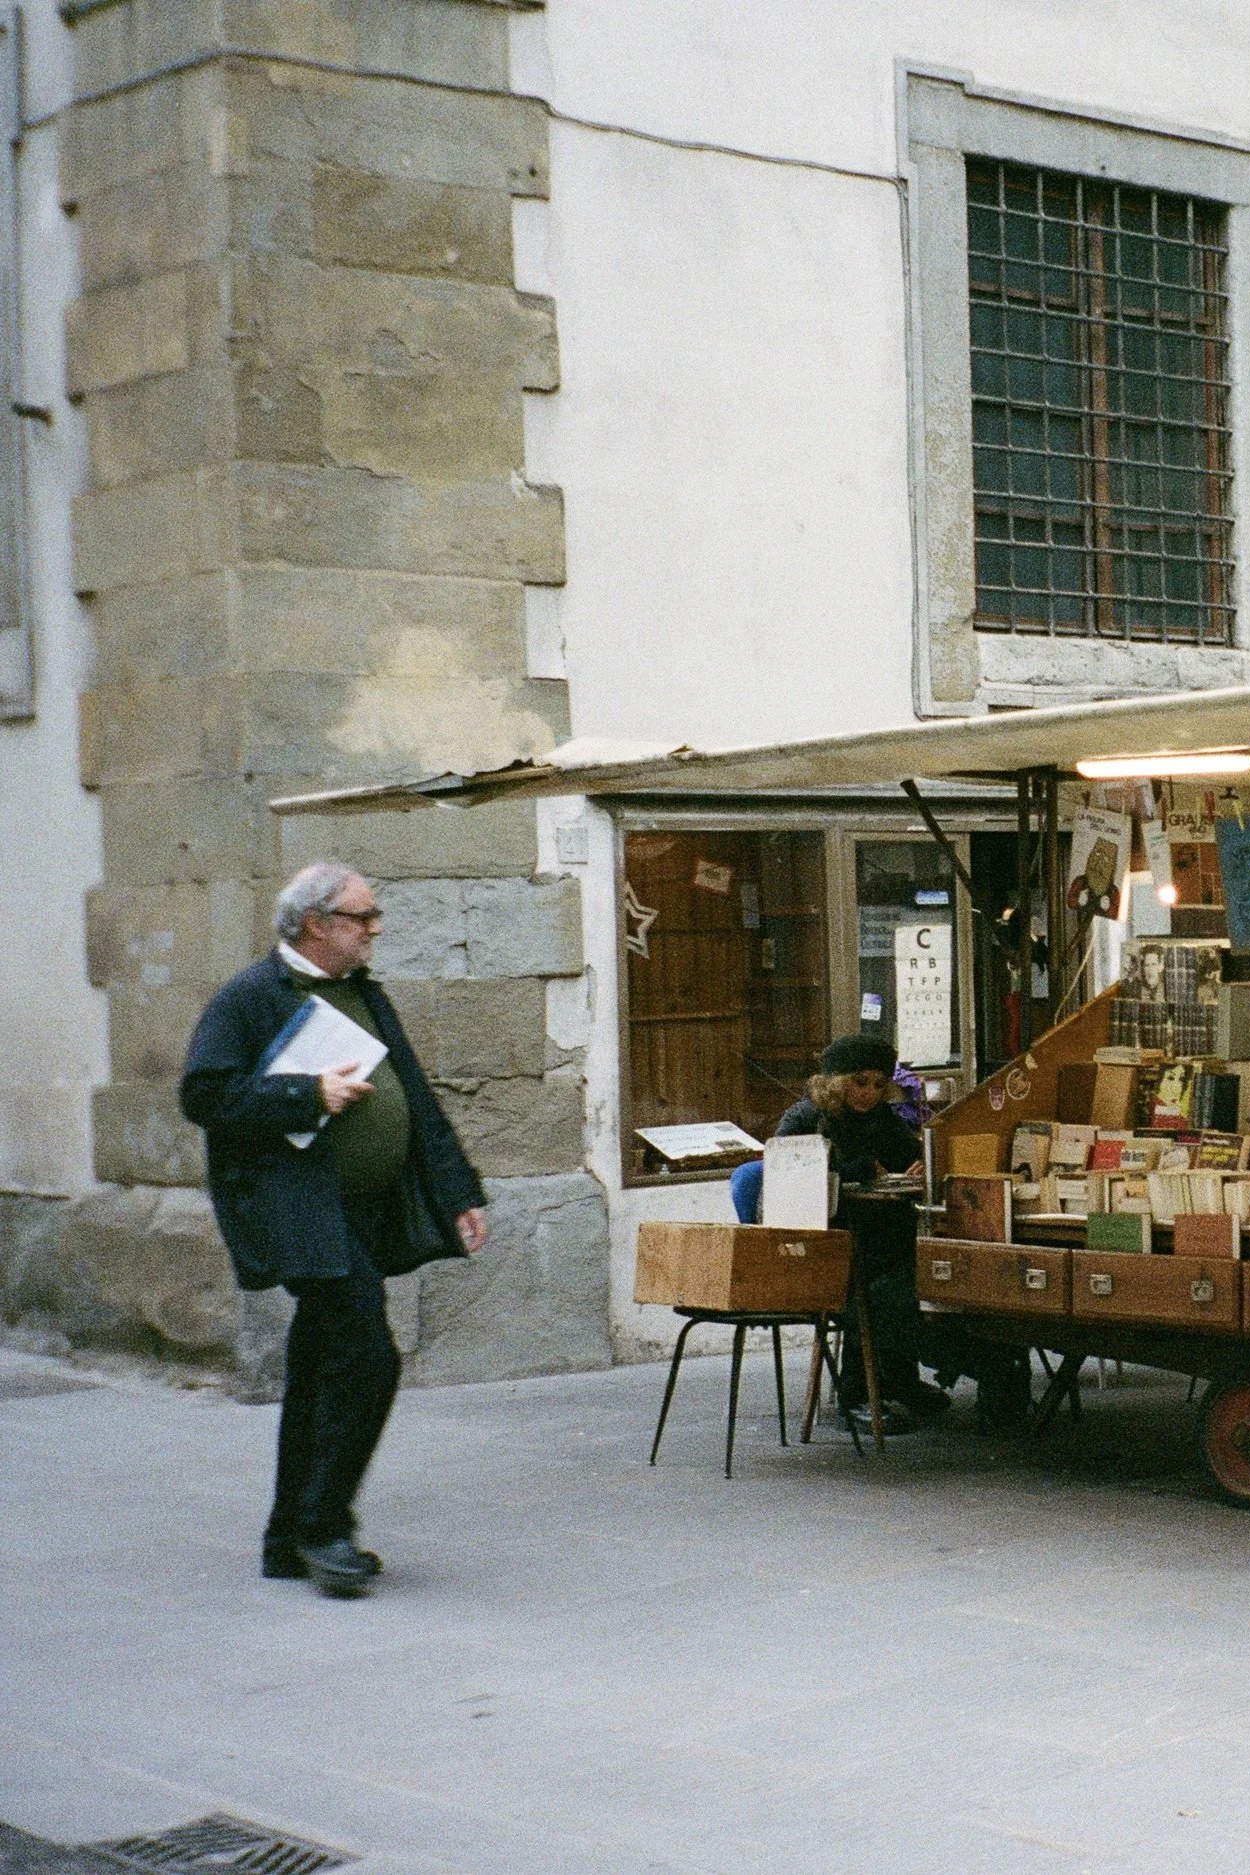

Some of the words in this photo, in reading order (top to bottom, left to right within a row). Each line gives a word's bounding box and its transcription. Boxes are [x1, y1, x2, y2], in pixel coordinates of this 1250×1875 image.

[916, 927, 932, 950] C
[910, 957, 918, 969] R
[928, 957, 937, 969] B
[907, 976, 914, 986] T
[921, 976, 928, 986] F
[934, 976, 941, 986] P
